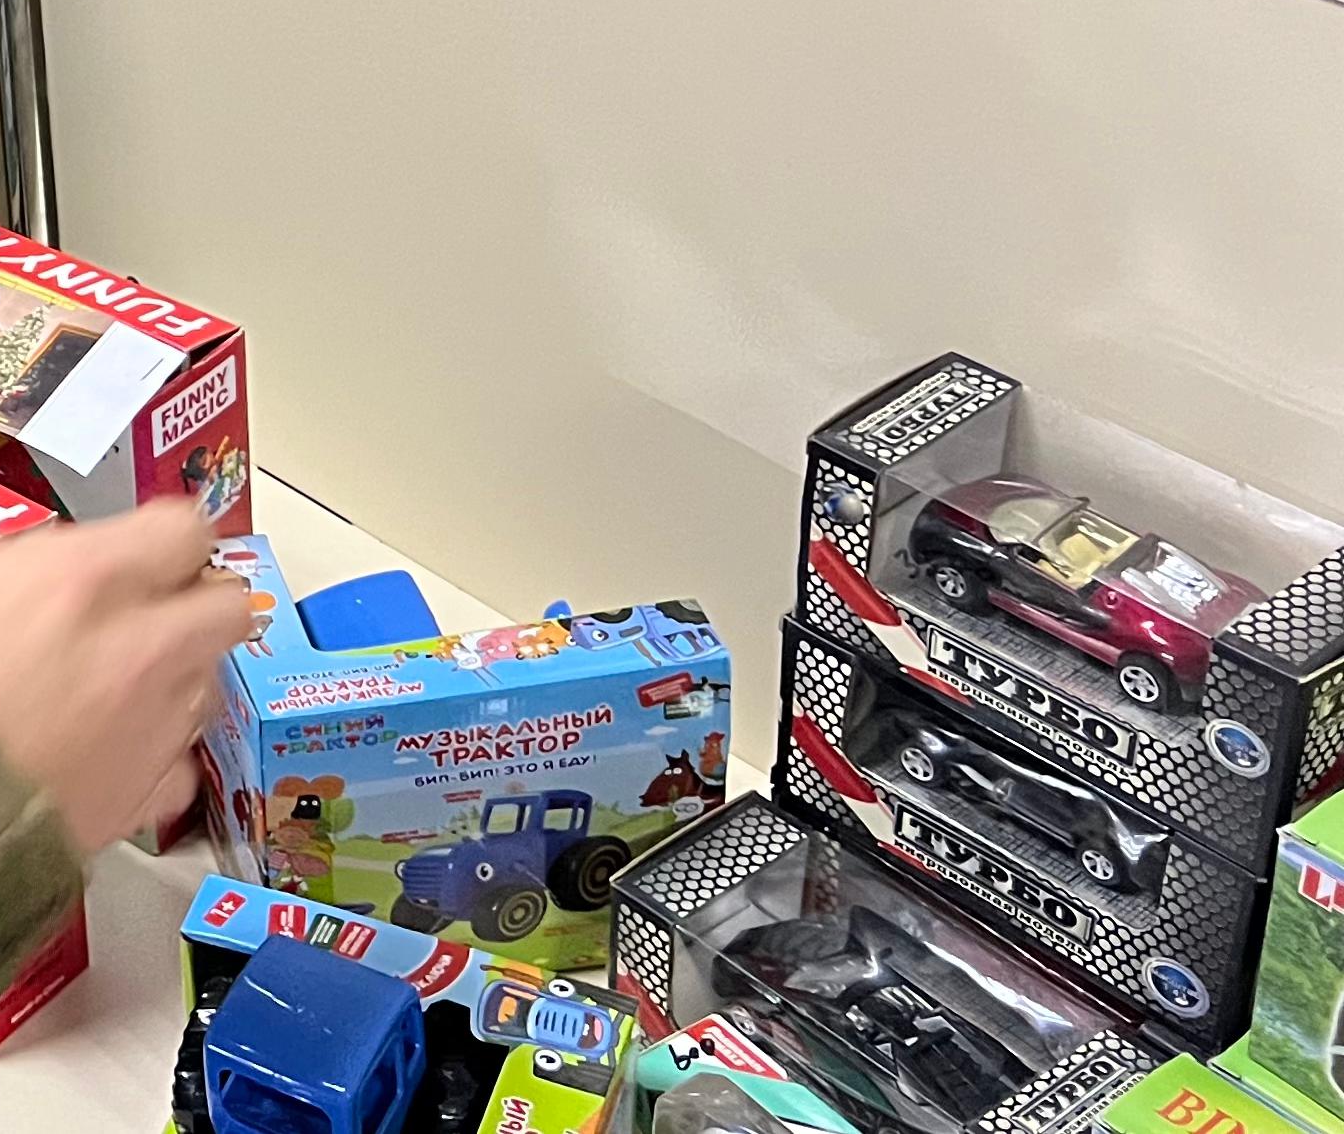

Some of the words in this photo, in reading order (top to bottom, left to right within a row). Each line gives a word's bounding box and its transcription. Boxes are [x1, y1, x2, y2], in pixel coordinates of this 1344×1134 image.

[0, 255, 213, 338] FUNNY
[161, 366, 228, 428] FUNNY
[162, 387, 230, 450] MAGIC
[883, 382, 975, 444] ТУРБО
[267, 682, 424, 714] МУЗЫКАЛЬНЫЙ
[287, 674, 396, 699] ТРАКТОР
[943, 641, 1119, 749] ТУРБО
[272, 729, 400, 756] ТРАКТОР
[285, 714, 385, 740] СИНИЙ
[395, 703, 613, 754] МУЗЫКАЛЬНЫЙ
[429, 731, 581, 768] ТРАКТОР
[927, 665, 1053, 737] инерционная
[1058, 734, 1130, 778] модель
[504, 762, 538, 776] ЭТО
[559, 754, 597, 770] ЕДУ!
[894, 839, 1015, 915] инерционная
[1019, 913, 1089, 958] модель
[909, 816, 1078, 928] ТУРБО
[1022, 1059, 1112, 1128] ТУРБО
